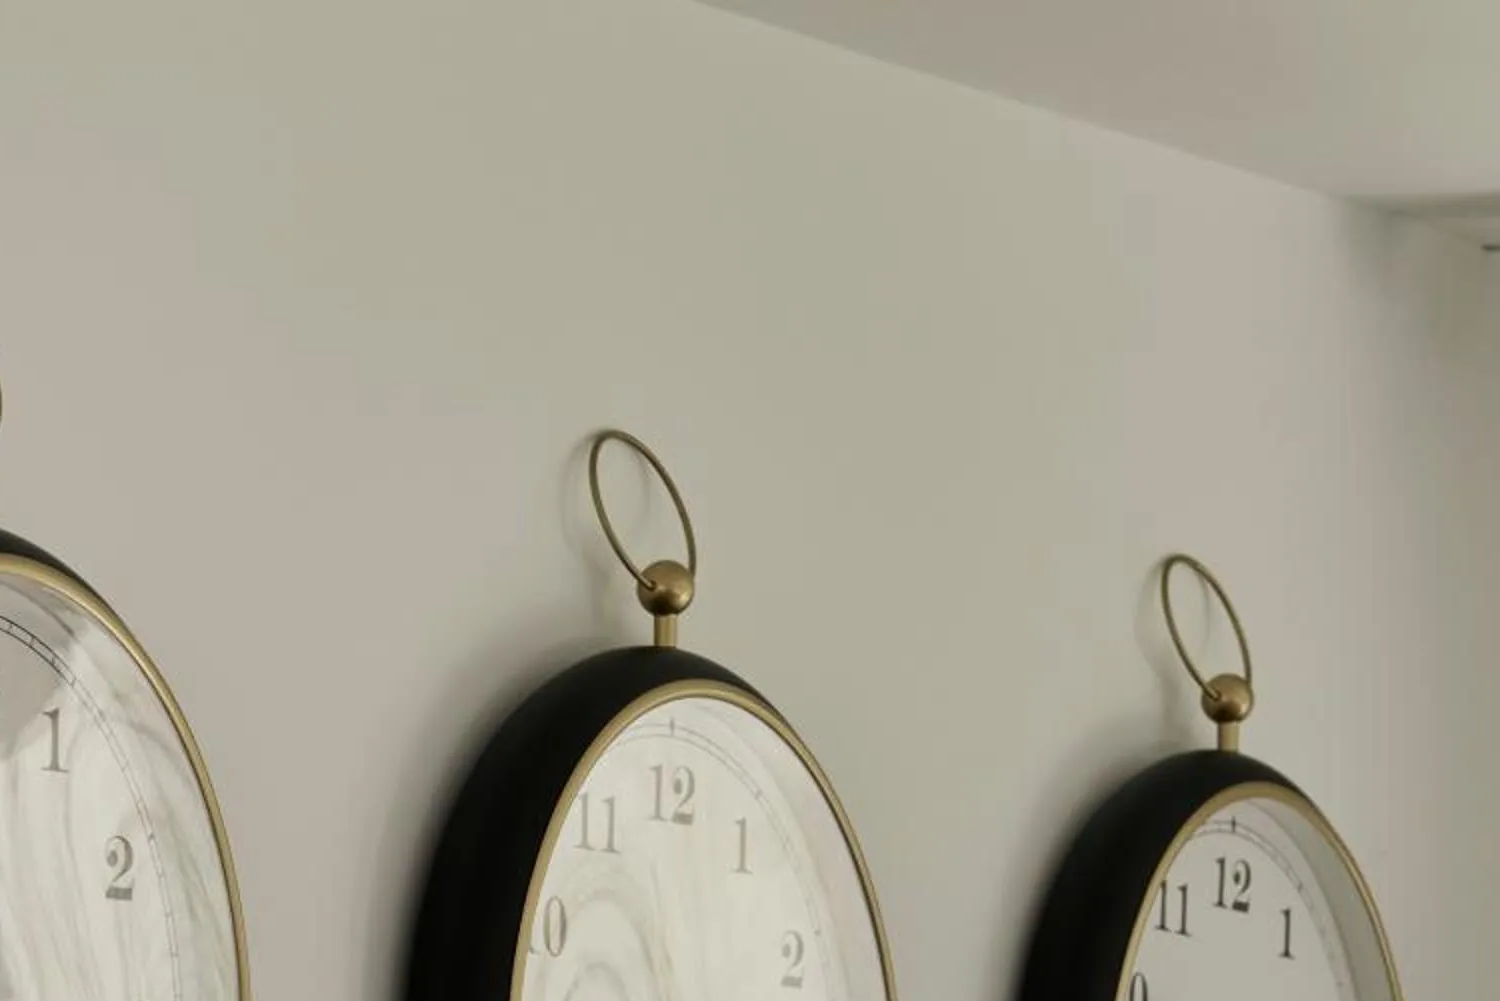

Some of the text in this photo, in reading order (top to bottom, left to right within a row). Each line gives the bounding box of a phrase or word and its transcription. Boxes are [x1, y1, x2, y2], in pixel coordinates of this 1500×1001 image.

[42, 708, 69, 773] 1
[572, 793, 621, 854] 11
[647, 764, 694, 825] 12
[105, 836, 133, 901] 2
[732, 817, 753, 875] 1
[1154, 880, 1192, 936] 11
[1213, 857, 1251, 913] 12
[528, 895, 566, 957] 0
[1277, 907, 1295, 960] 1
[780, 930, 805, 988] 2
